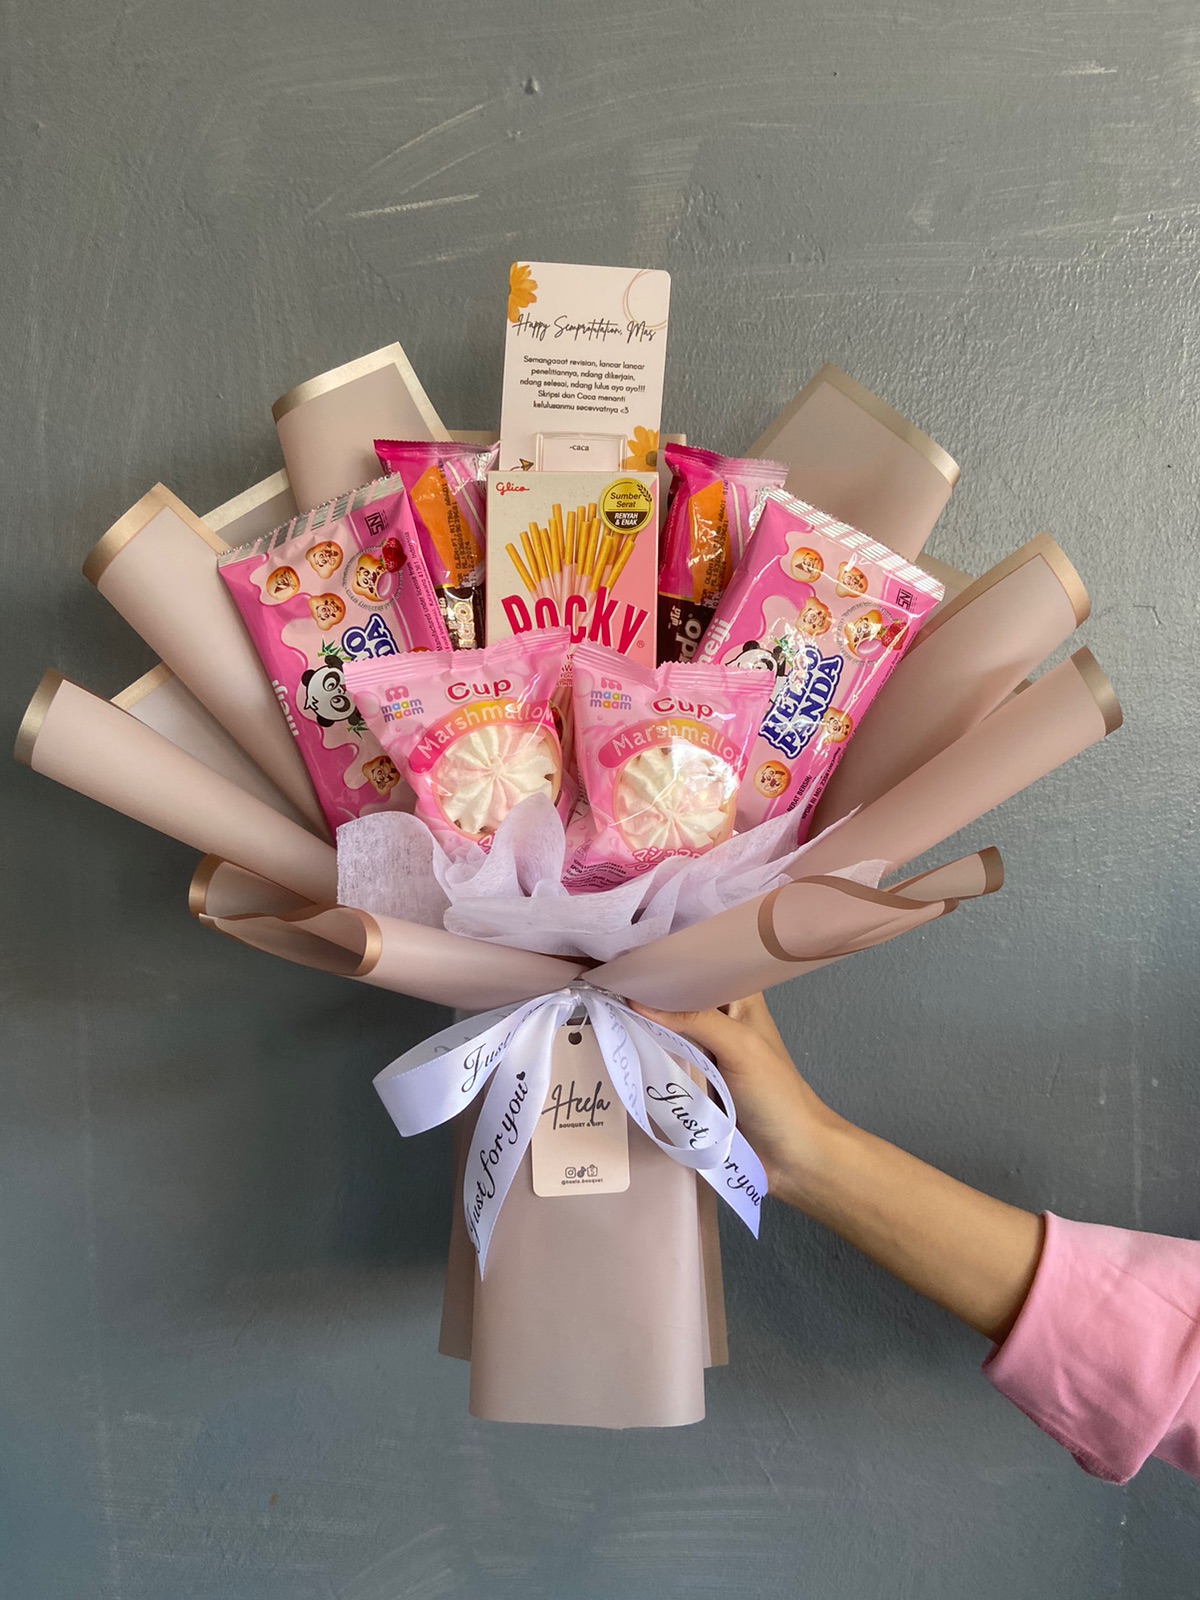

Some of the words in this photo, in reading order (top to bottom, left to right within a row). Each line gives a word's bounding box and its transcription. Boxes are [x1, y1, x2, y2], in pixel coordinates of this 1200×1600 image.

[512, 312, 550, 342] Happy
[626, 320, 656, 343] Mas
[599, 359, 621, 368] lancar
[622, 361, 645, 370] lancar
[580, 370, 603, 380] ndang
[604, 371, 636, 381] dikerjain,
[519, 377, 542, 388] ndang
[543, 379, 569, 388] selesai,
[570, 380, 593, 391] ndang
[594, 381, 610, 390] lulus
[611, 385, 624, 393] ayo
[625, 385, 646, 393] ayo!!!
[537, 390, 560, 400] Skripsi
[561, 391, 576, 399] dan
[576, 392, 597, 400] Caca
[533, 400, 575, 410] kelulusanmu
[496, 481, 530, 495] Glico
[610, 492, 642, 500] Sumber
[621, 518, 638, 526] ENAK
[501, 586, 648, 654] POCKY
[447, 678, 512, 701] Cup
[590, 690, 632, 702] maam
[381, 698, 422, 714] maam
[590, 698, 632, 711] maam
[652, 697, 713, 719] Cup
[777, 658, 840, 756] PANDA
[383, 706, 425, 723] maam
[786, 795, 800, 812] BERAT
[461, 1031, 511, 1093] Just
[541, 1080, 611, 1130] Heela
[646, 1082, 709, 1140] Just
[480, 1135, 504, 1198] for
[501, 1081, 529, 1144] you
[727, 1170, 762, 1206] you
